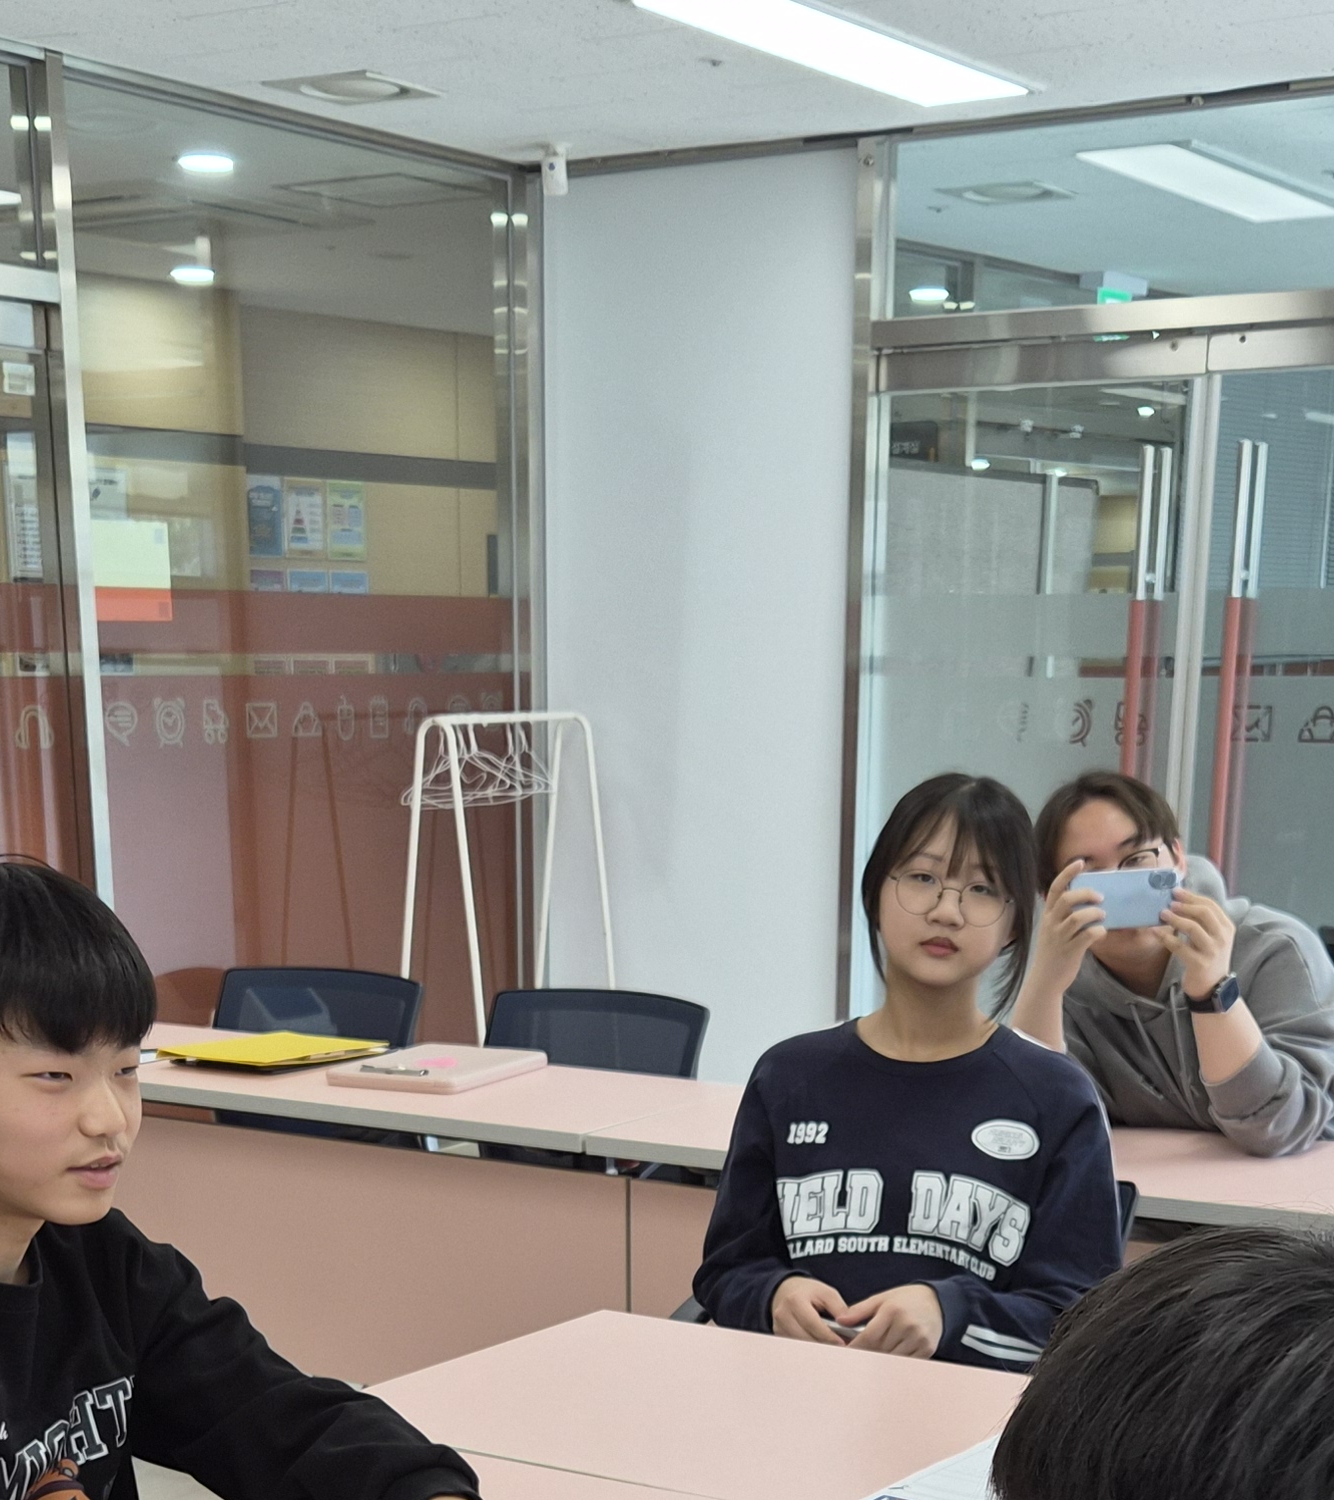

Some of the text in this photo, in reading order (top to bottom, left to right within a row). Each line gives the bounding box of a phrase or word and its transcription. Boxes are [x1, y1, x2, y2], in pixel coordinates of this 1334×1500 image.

[787, 1121, 829, 1145] 1992
[907, 1170, 1031, 1267] DAYS
[837, 1236, 890, 1253] SOUTH
[892, 1236, 971, 1269] ELEMENTARY
[970, 1255, 996, 1281] CLUB
